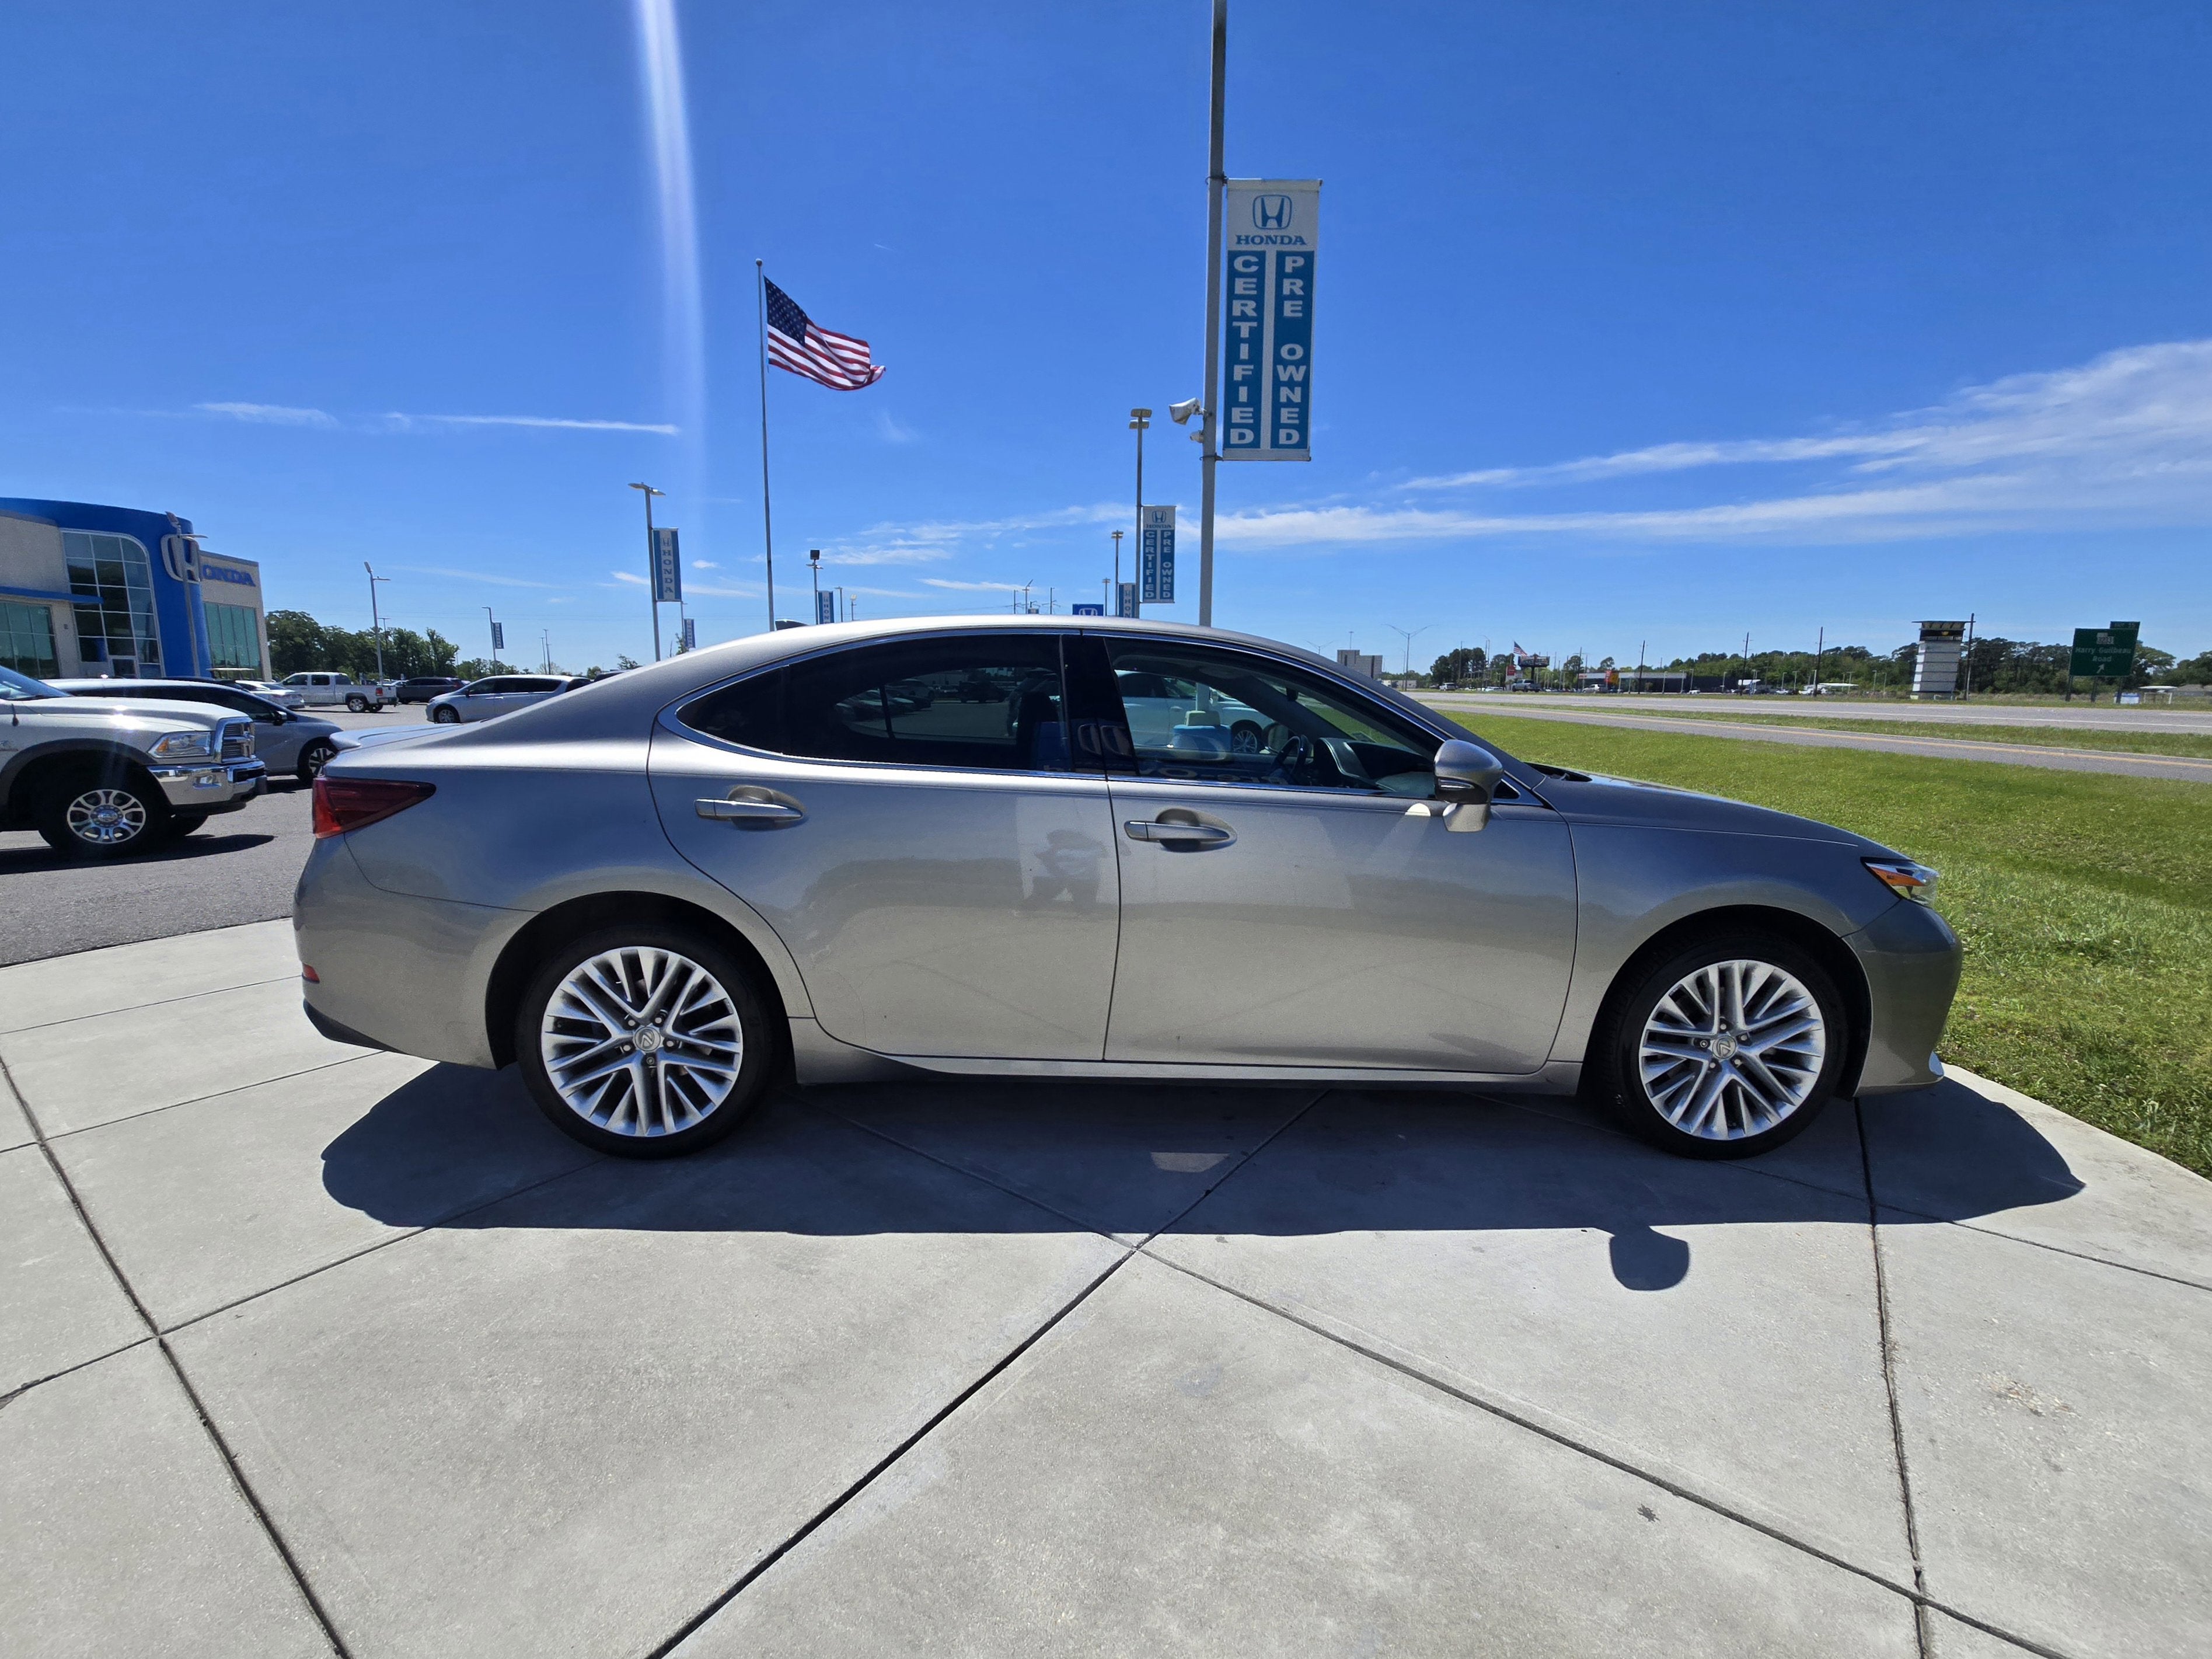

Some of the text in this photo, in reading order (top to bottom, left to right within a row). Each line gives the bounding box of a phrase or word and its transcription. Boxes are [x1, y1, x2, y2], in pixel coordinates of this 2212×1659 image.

[1236, 234, 1307, 246] HONDA
[1230, 255, 1259, 445] CERTIFIED
[1276, 255, 1307, 445] PRE OWNED
[201, 564, 256, 587] ONDA
[662, 549, 674, 593] HONDA
[1145, 531, 1154, 598] CERTIFIED
[1161, 532, 1173, 598] PRE OWNED
